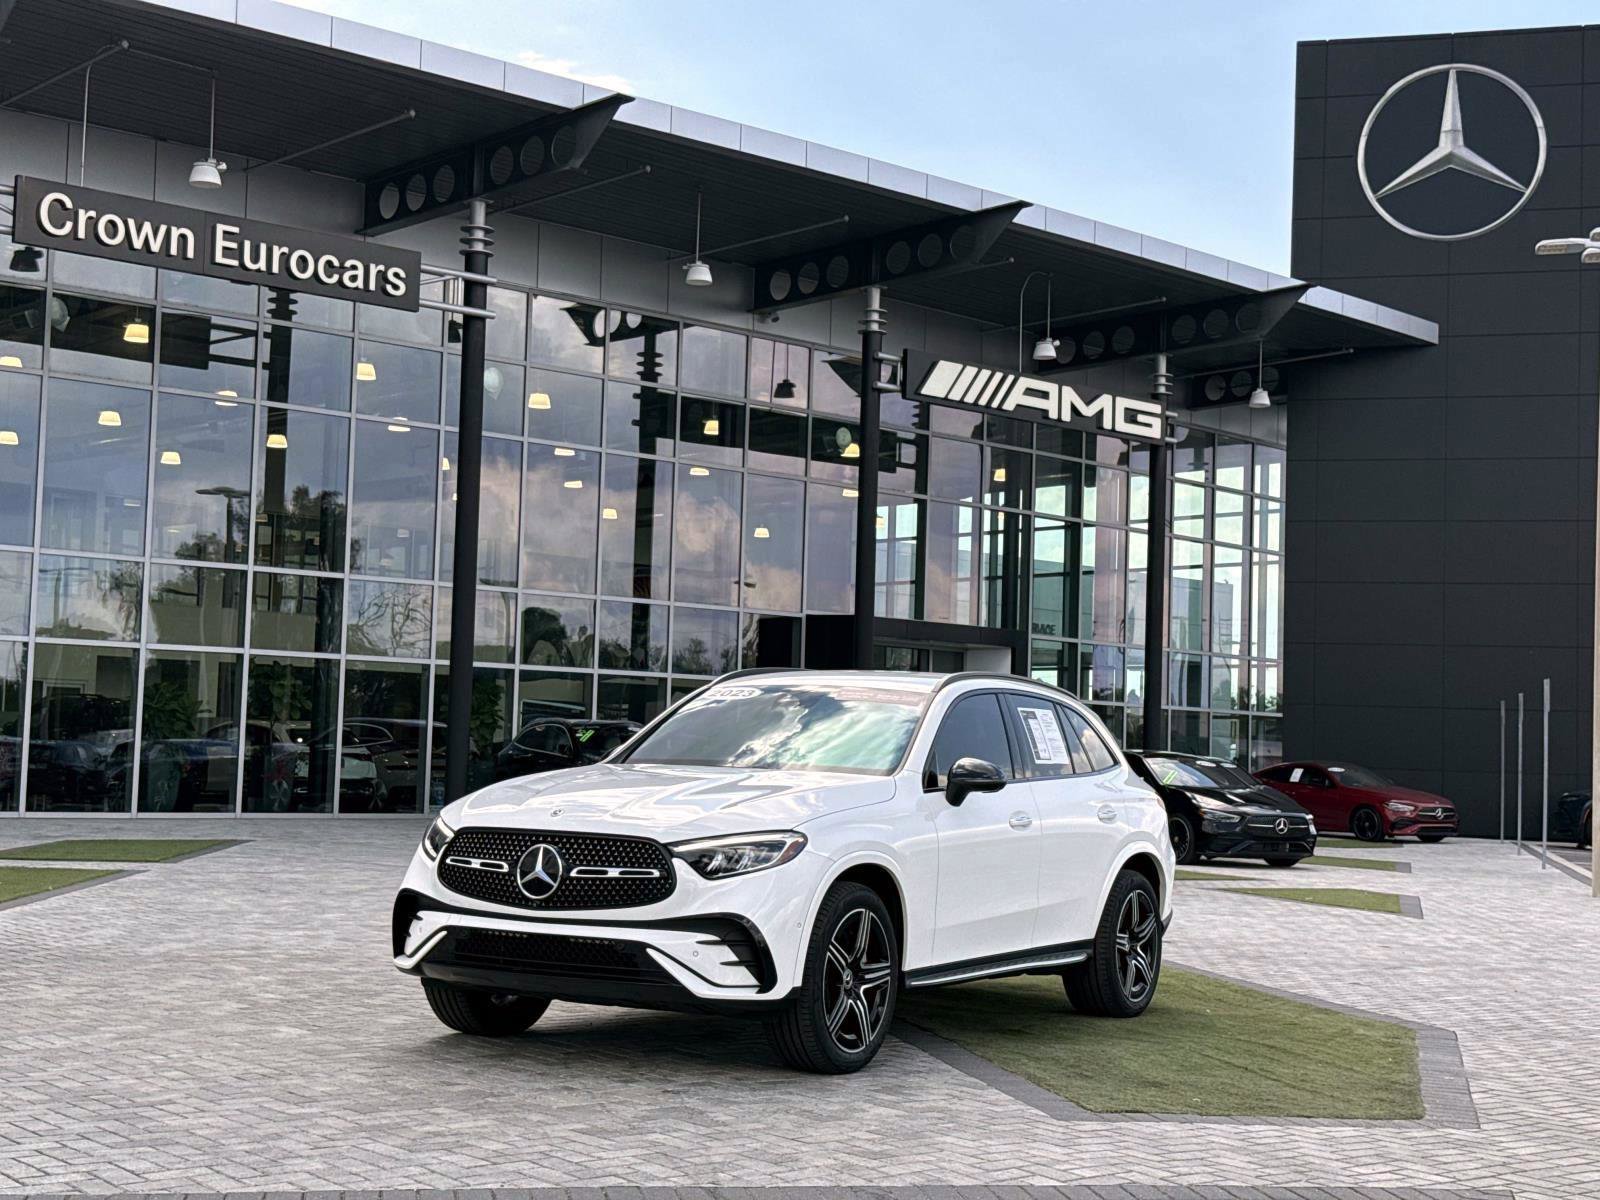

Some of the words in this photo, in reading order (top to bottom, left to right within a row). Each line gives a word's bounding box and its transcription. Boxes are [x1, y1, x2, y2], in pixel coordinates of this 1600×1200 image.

[38, 192, 195, 259] Crown
[213, 223, 408, 296] Eurocars
[1002, 376, 1161, 439] AMG
[708, 689, 755, 697] 2023
